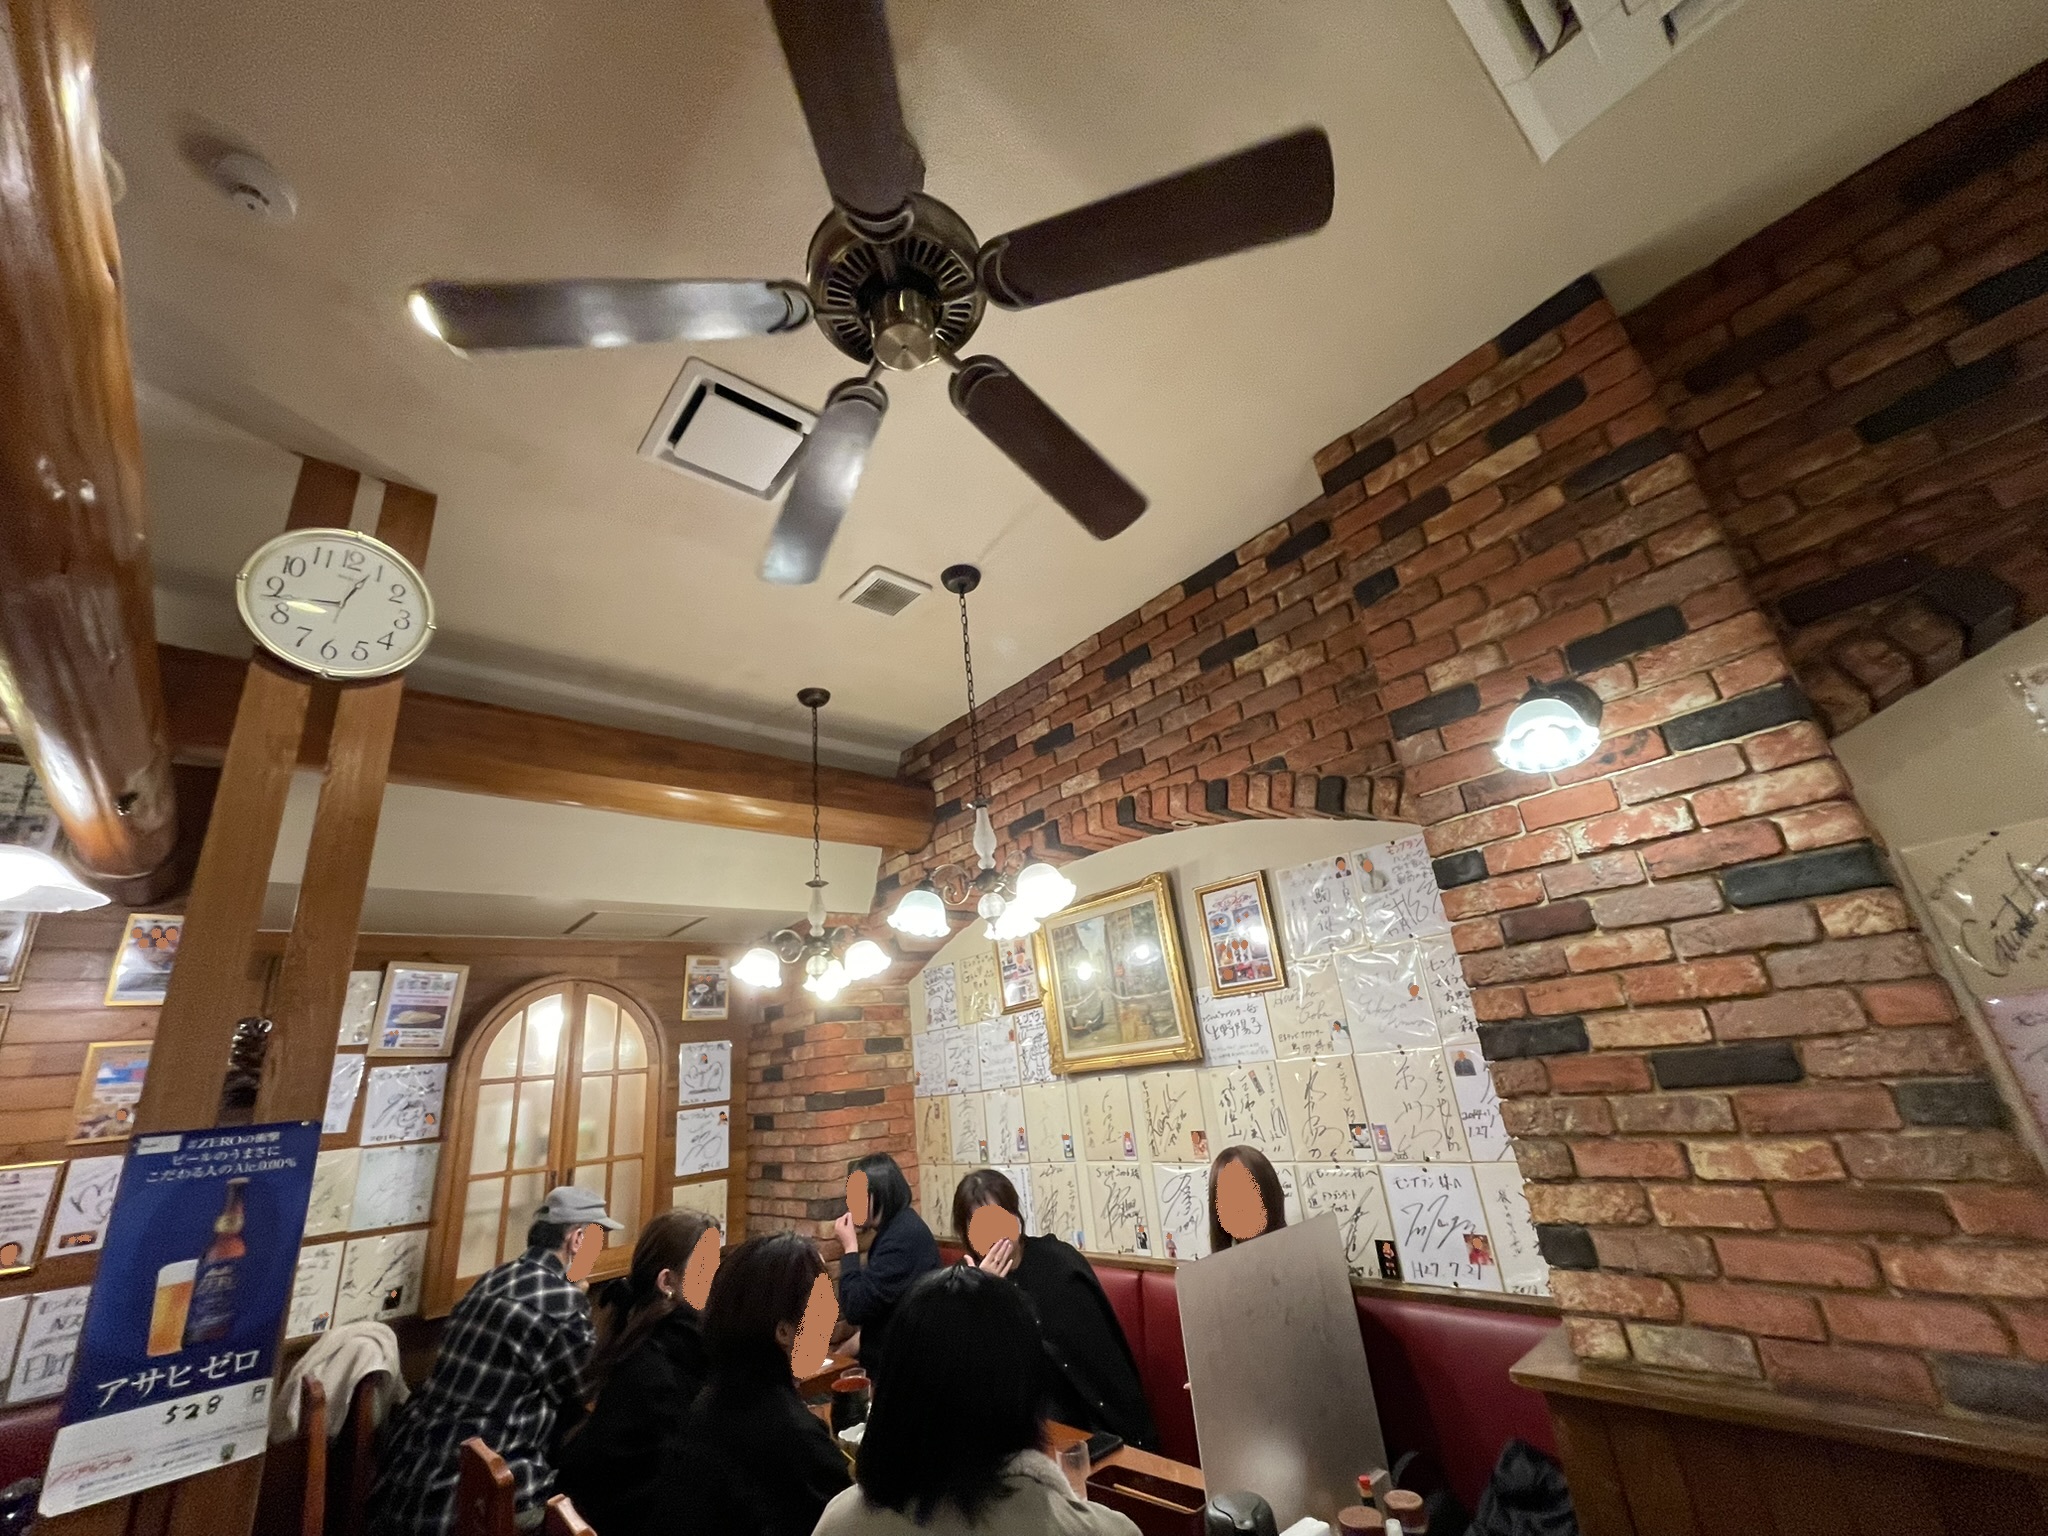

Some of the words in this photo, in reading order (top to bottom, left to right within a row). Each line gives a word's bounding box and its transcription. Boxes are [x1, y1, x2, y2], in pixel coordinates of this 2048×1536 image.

[282, 555, 307, 578] 10
[313, 547, 333, 568] 11
[342, 550, 365, 572] 12
[375, 565, 384, 583] 1
[389, 583, 406, 604] 2
[270, 603, 290, 625] 8
[393, 609, 411, 630] 3
[296, 626, 313, 648] 7
[377, 631, 395, 651] 4
[320, 639, 338, 660] 6
[351, 641, 369, 661] 5
[163, 1395, 224, 1425] 528
